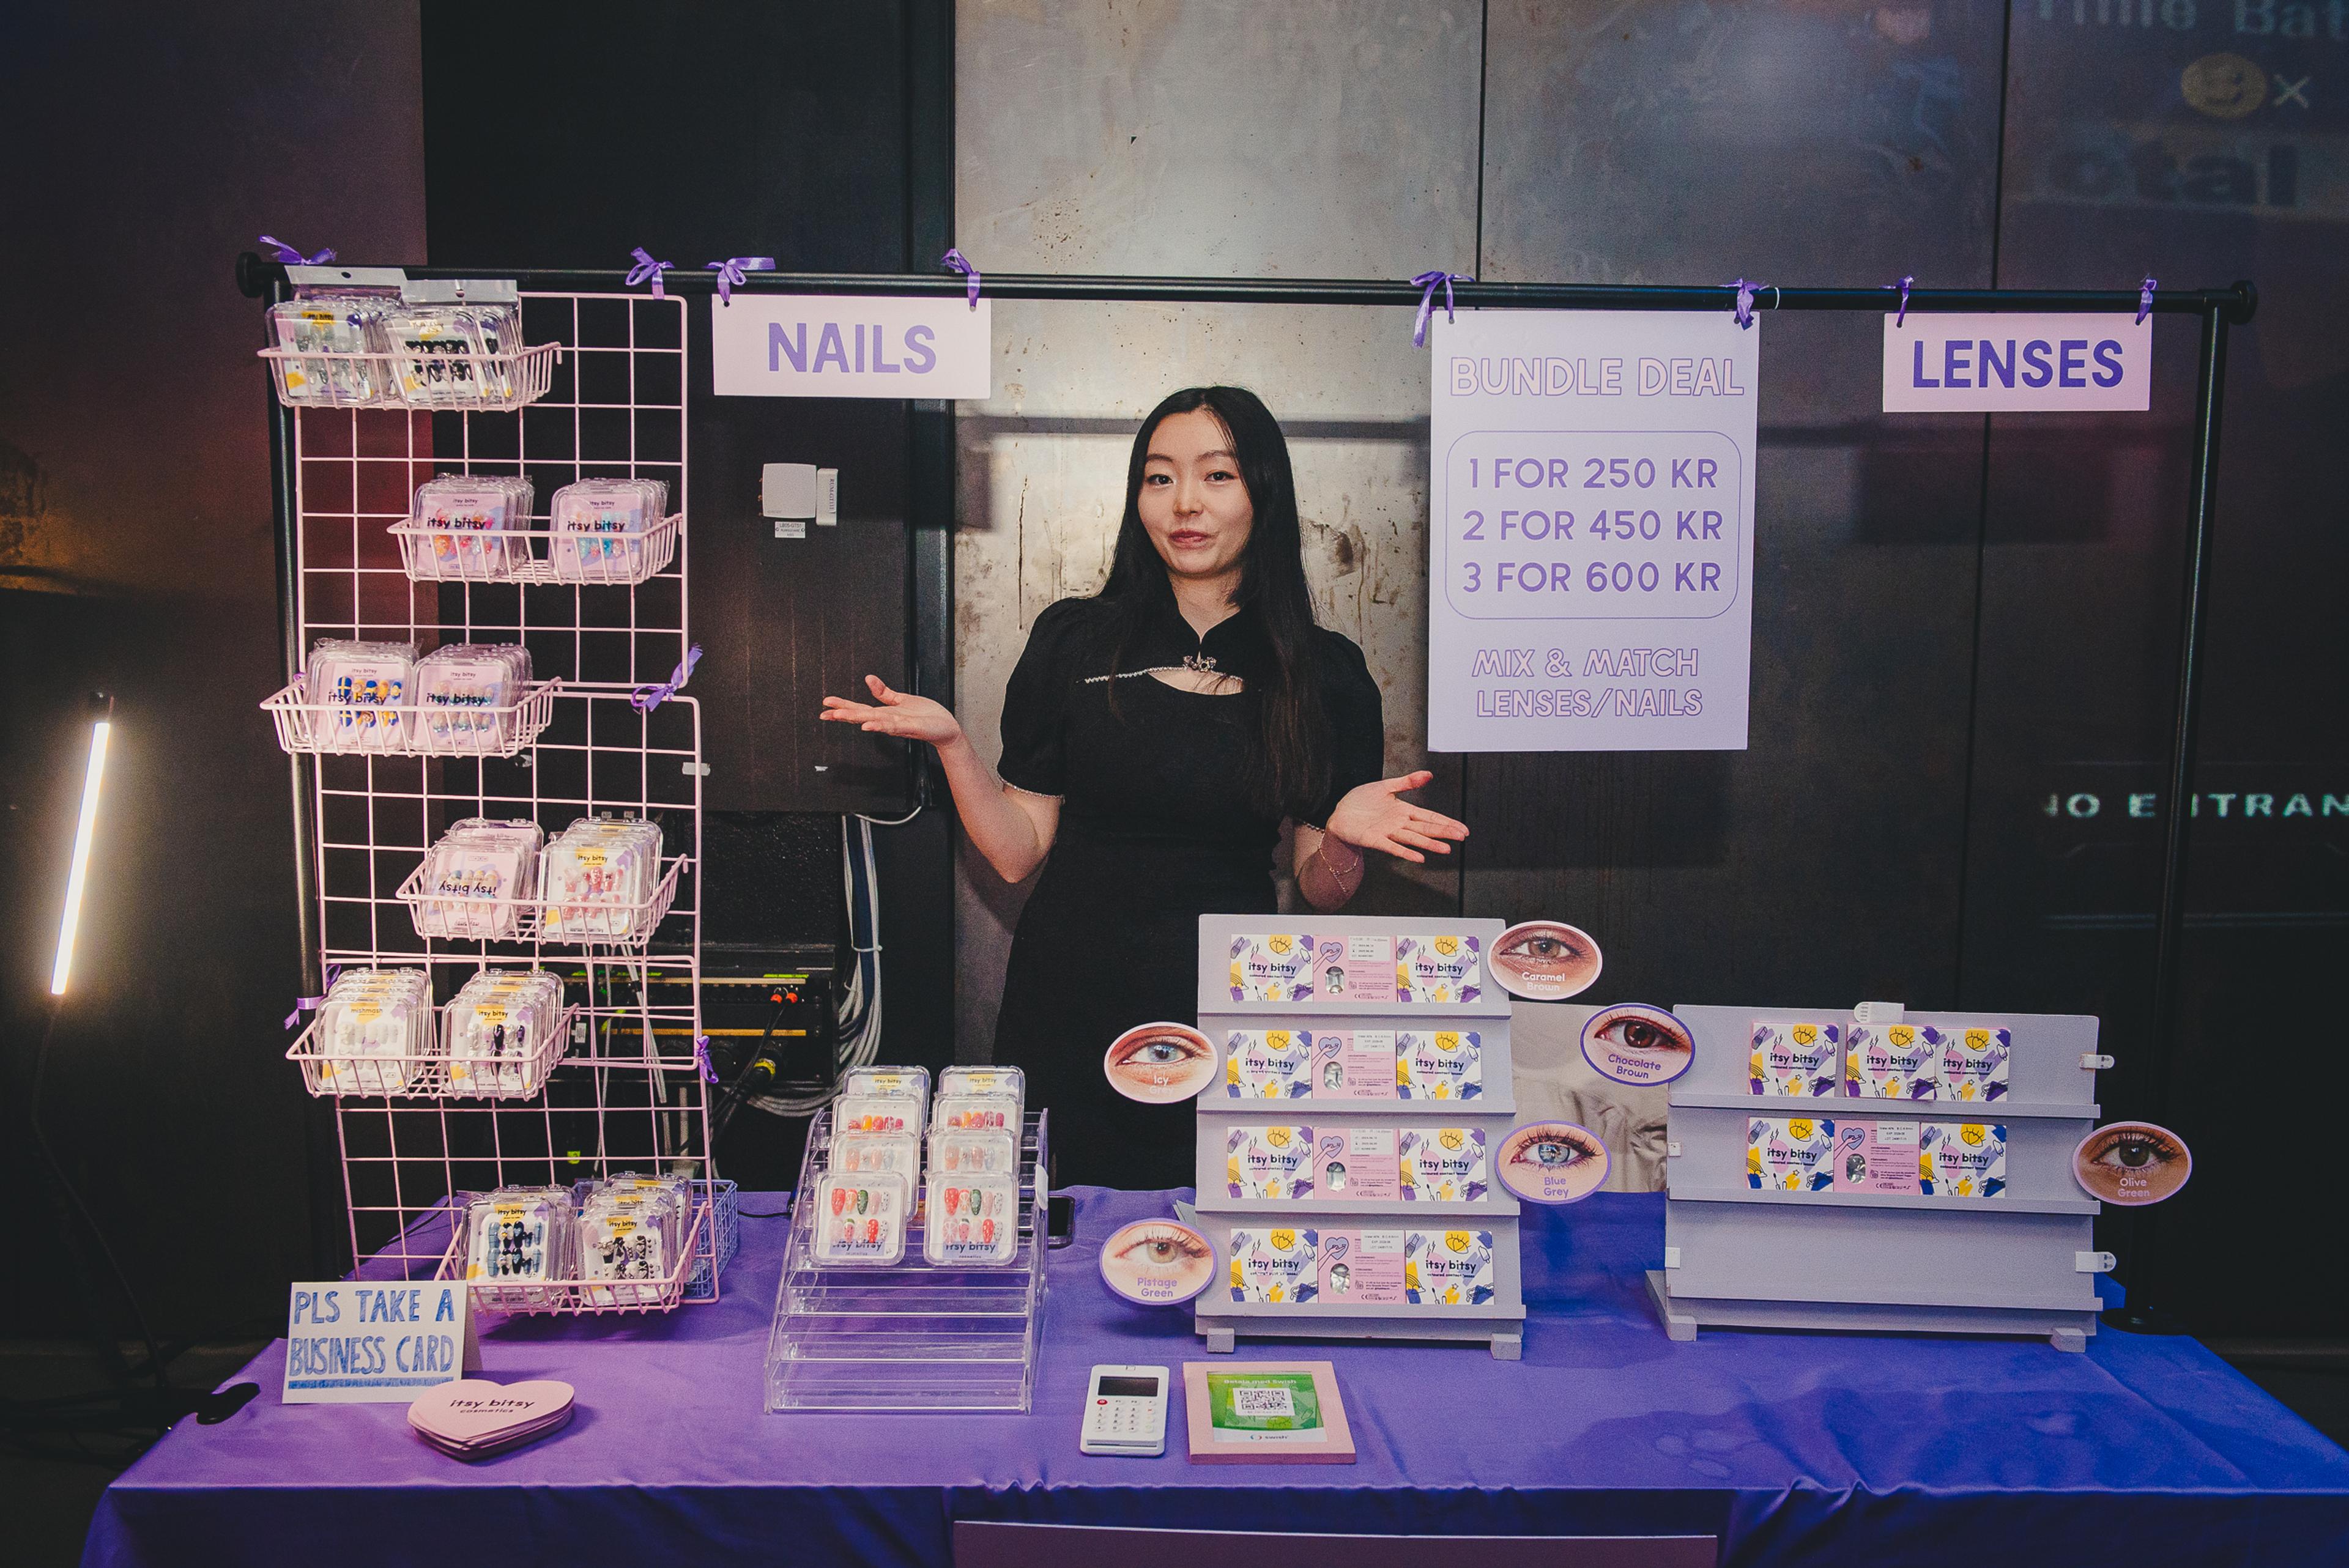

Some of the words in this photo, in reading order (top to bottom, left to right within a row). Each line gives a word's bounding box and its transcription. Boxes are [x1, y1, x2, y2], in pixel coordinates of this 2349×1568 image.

[768, 322, 937, 374] NAILS
[1913, 339, 2124, 388] LENSES
[1450, 357, 1622, 396] BUNDLE
[1638, 358, 1744, 396] DEAL
[1469, 458, 1477, 487] 1
[1494, 458, 1568, 488] FOR
[1583, 457, 1655, 489] 250
[1671, 458, 1718, 488] KR
[427, 517, 449, 530] itsy
[454, 517, 486, 530] bitsy
[567, 520, 590, 532] itsy
[595, 520, 625, 532] bitsy
[1463, 510, 1485, 541] 2
[1501, 510, 1575, 541] FOR
[1589, 509, 1661, 541] 450
[1676, 510, 1723, 541] KR
[1463, 562, 1481, 593] 3
[1497, 562, 1571, 592] FOR
[1586, 562, 1659, 593] 600
[1675, 562, 1721, 593] KR
[1472, 649, 1535, 678] MIX
[1545, 648, 1572, 678] &
[1583, 648, 1698, 678] MATCH
[328, 690, 351, 704] itsy
[355, 693, 386, 704] bitsy
[426, 692, 450, 705] itsy
[453, 693, 485, 706] bitsy
[1477, 689, 1703, 718] LENSES/NAILS
[439, 881, 470, 895] bitsy
[473, 882, 496, 897] itsy
[1249, 962, 1267, 974] itsy
[1271, 962, 1296, 974] bitsy
[1416, 963, 1434, 974] itsy
[1438, 963, 1463, 974] bitsy
[1522, 972, 1565, 982] Caramel
[1527, 982, 1560, 991] Brown
[478, 1010, 491, 1019] itsy
[492, 1010, 508, 1019] bitsy
[1245, 1057, 1264, 1070] itsy
[1268, 1058, 1294, 1071] bitsy
[1416, 1058, 1434, 1070] itsy
[1438, 1059, 1464, 1071] bitsy
[1608, 1054, 1661, 1070] Chocolate
[1770, 1052, 1789, 1064] itsy
[1793, 1053, 1819, 1065] bitsy
[1866, 1054, 1887, 1066] itsy
[1890, 1056, 1918, 1068] bitsy
[1943, 1058, 1964, 1068] itsy
[1965, 1059, 1993, 1071] bitsy
[1616, 1066, 1649, 1079] Brown
[887, 1077, 902, 1085] bitsy
[970, 1076, 979, 1085] itsy
[981, 1076, 997, 1085] bitsy
[1154, 1075, 1169, 1086] Icy
[1149, 1085, 1174, 1096] Grey
[1248, 1155, 1267, 1166] itsy
[1271, 1155, 1297, 1167] bitsy
[1767, 1147, 1787, 1159] itsy
[1791, 1148, 1817, 1162] bitsy
[1939, 1152, 1959, 1164] itsy
[1962, 1153, 1989, 1166] bitsy
[1419, 1159, 1439, 1170] itsy
[1443, 1159, 1469, 1171] bitsy
[1544, 1177, 1566, 1185] Blue
[2120, 1178, 2147, 1186] Olive
[1544, 1187, 1568, 1198] Grey
[2118, 1188, 2150, 1197] Green
[497, 1208, 510, 1216] itsy
[511, 1207, 526, 1216] bitsy
[1249, 1259, 1269, 1270] itsy
[1273, 1259, 1299, 1271] bitsy
[1426, 1260, 1445, 1272] itsy
[1449, 1260, 1476, 1272] bitsy
[1138, 1278, 1177, 1289] Pistage
[1141, 1288, 1173, 1297] Green
[294, 1290, 341, 1325] PLS
[355, 1289, 421, 1323] TAKE
[436, 1289, 455, 1322] A
[289, 1335, 386, 1376] BUSINESS
[396, 1334, 455, 1372] CARD
[450, 1400, 484, 1409] itsy
[489, 1399, 535, 1409] bitsy
